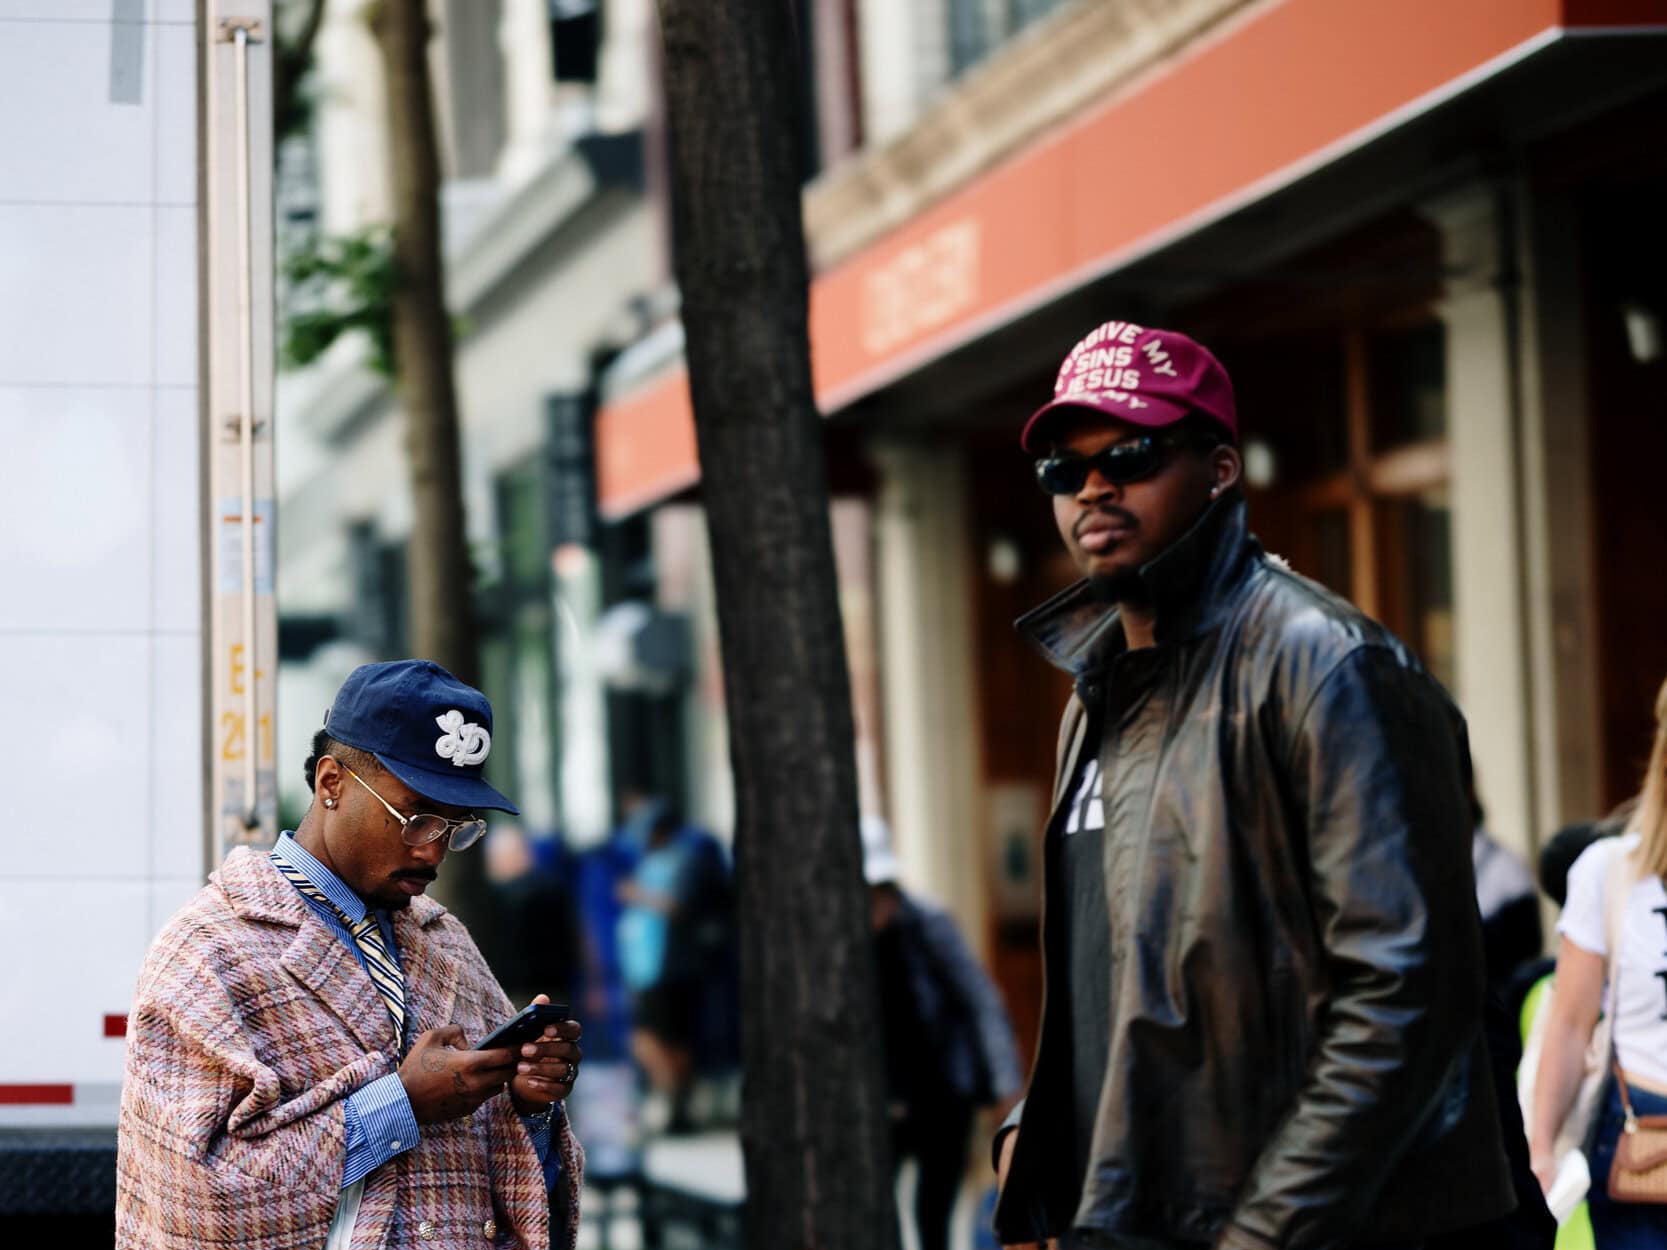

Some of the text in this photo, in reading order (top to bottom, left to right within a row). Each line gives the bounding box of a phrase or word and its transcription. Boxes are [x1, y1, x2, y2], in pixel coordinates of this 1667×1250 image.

[1074, 346, 1133, 374] SINS
[1142, 339, 1177, 376] MY
[1067, 367, 1141, 393] JESUS
